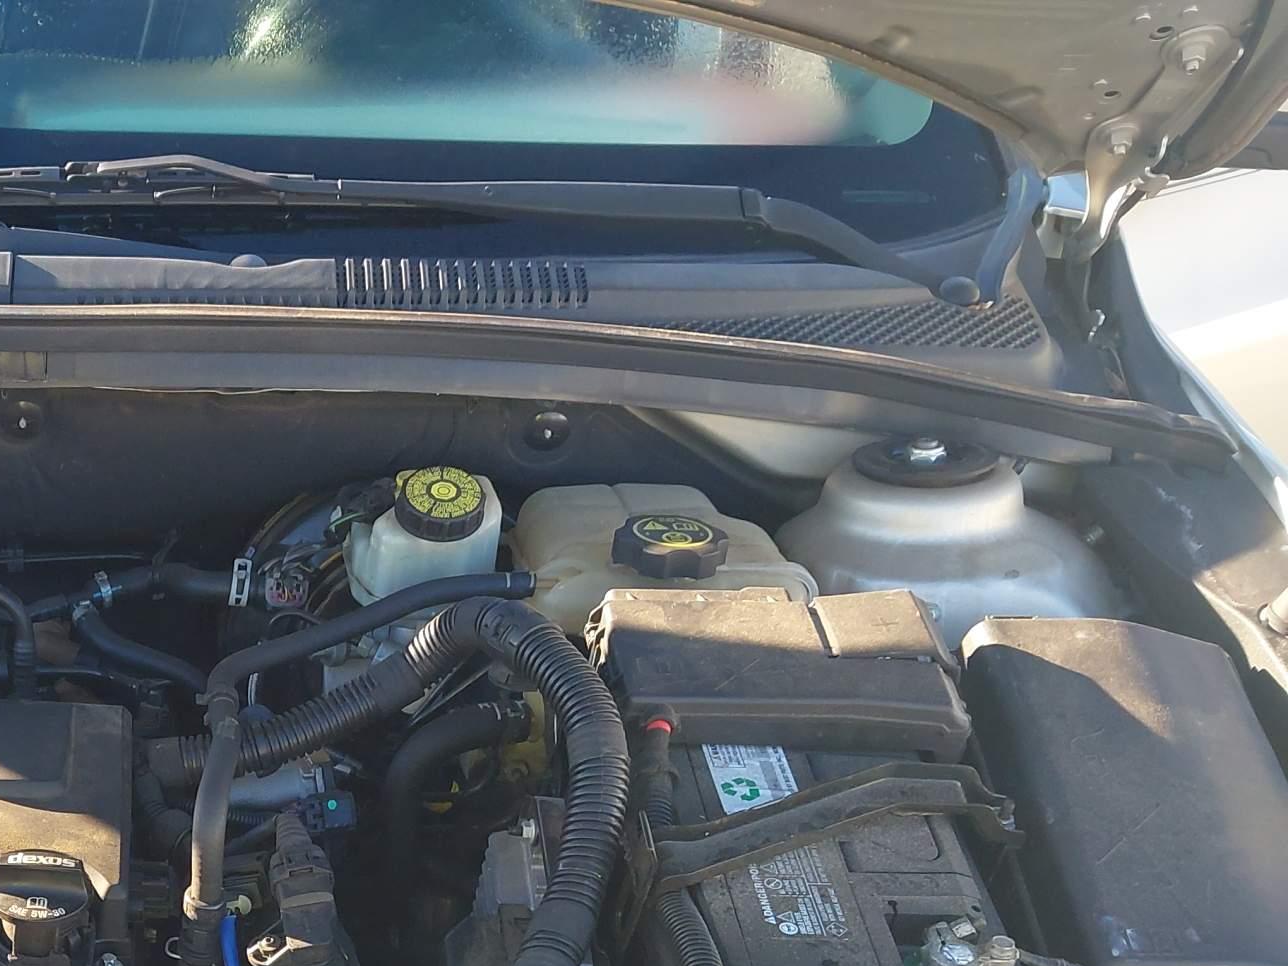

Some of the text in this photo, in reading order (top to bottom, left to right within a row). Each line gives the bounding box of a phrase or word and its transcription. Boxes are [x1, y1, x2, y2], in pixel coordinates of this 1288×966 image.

[7, 852, 76, 868] dexos
[8, 904, 66, 919] SAE 5W-30
